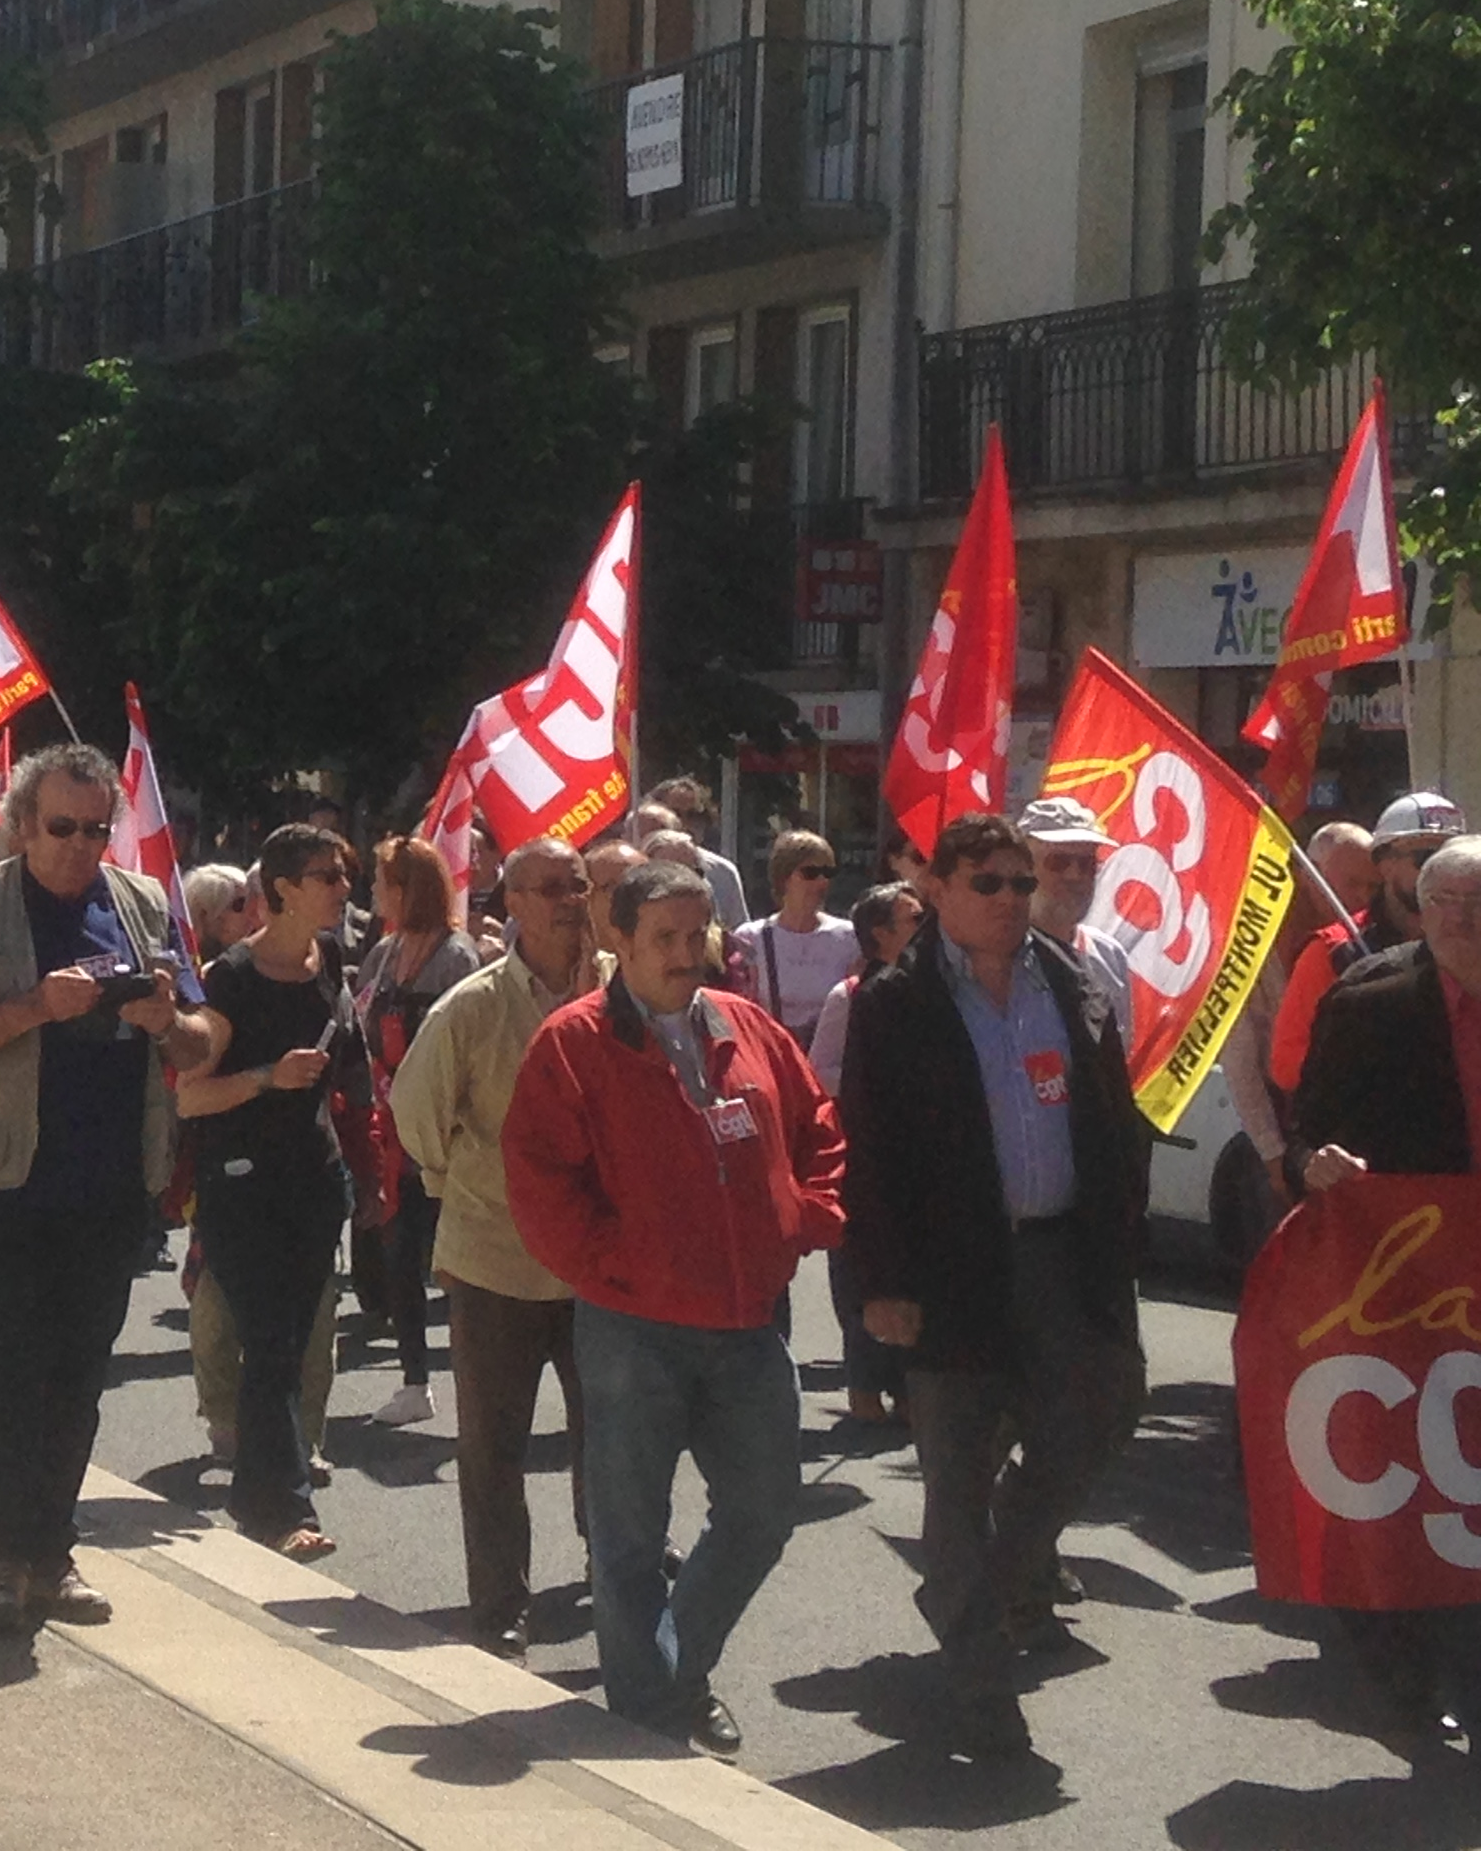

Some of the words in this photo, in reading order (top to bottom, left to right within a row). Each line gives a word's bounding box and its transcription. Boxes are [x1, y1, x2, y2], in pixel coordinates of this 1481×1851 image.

[717, 1110, 752, 1138] cgt
[1034, 1073, 1068, 1102] cgt
[1297, 1204, 1481, 1349] la
[1285, 1350, 1481, 1569] cg
